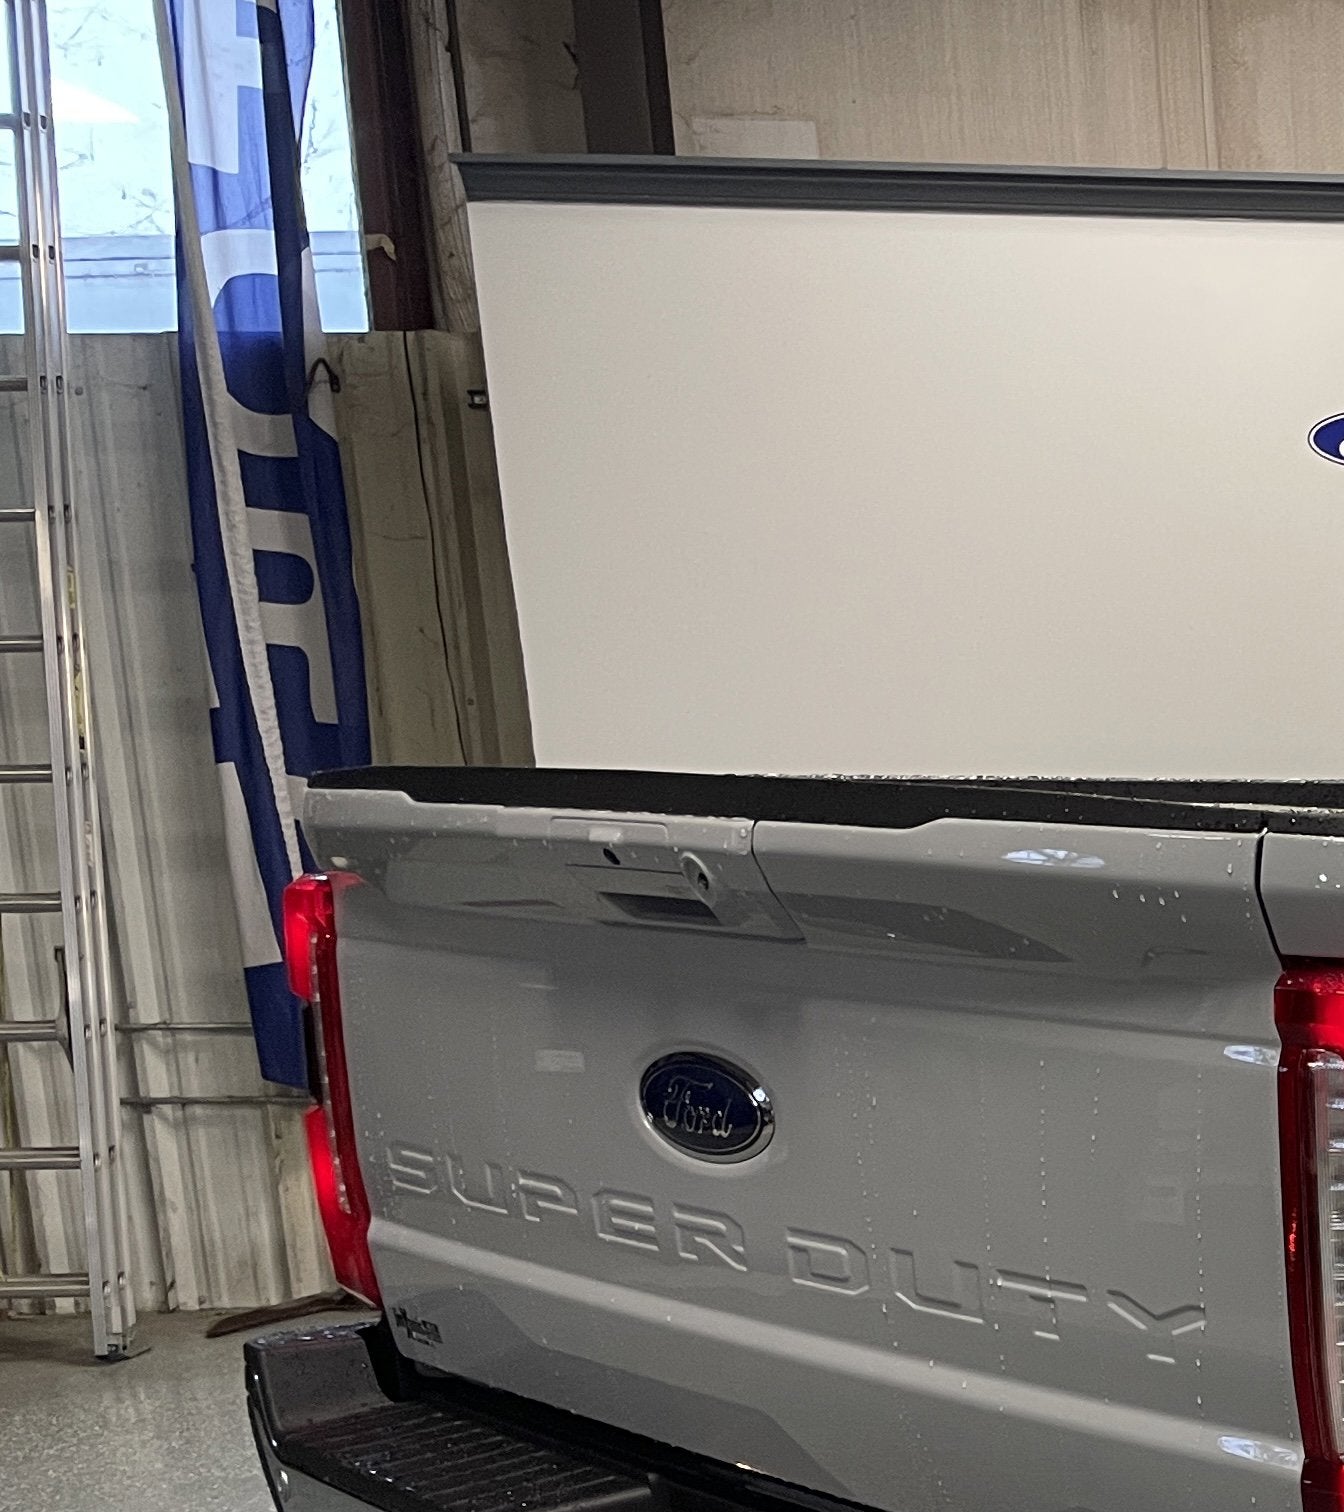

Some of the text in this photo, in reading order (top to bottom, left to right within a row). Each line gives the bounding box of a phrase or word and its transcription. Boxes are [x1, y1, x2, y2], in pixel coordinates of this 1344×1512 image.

[663, 1075, 733, 1138] Ford
[387, 1142, 1207, 1364] SUPER DUTY
